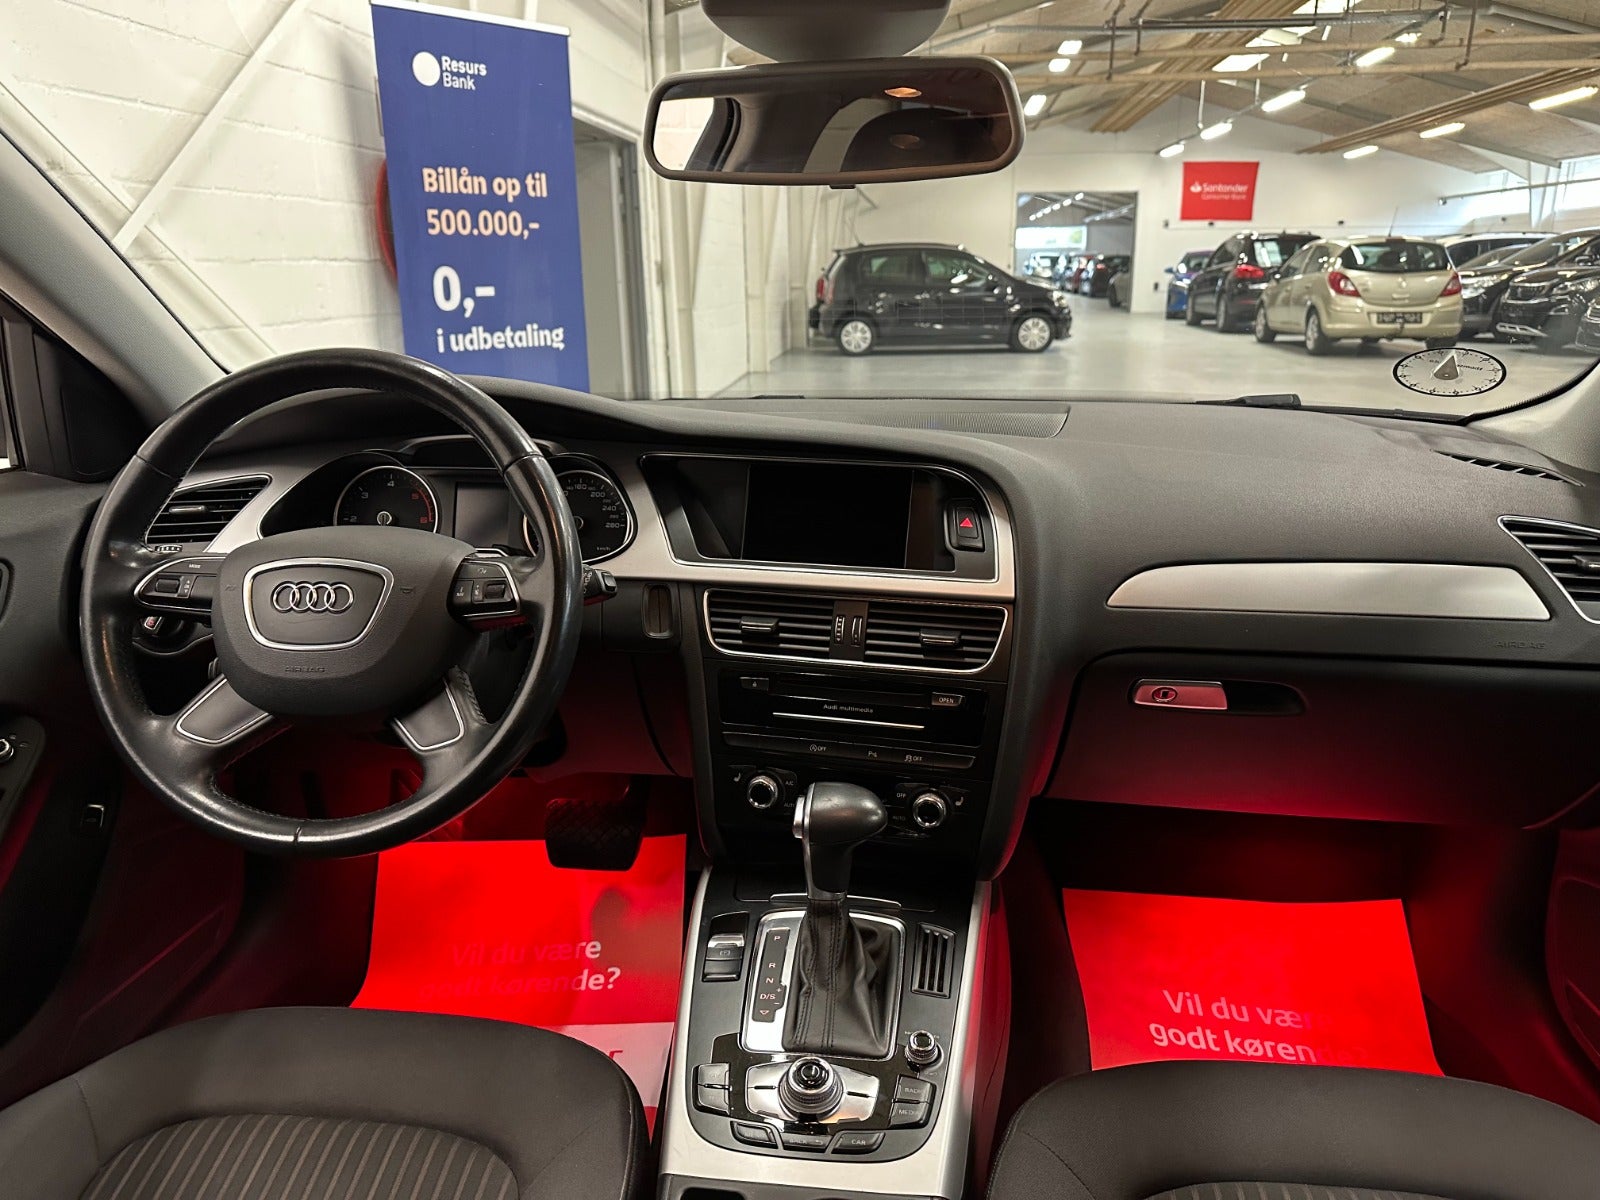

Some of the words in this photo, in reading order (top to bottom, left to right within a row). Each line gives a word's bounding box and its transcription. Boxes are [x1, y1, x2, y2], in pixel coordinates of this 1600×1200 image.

[441, 56, 487, 76] Resurs
[442, 73, 476, 90] Bank
[422, 167, 487, 195] Billån
[492, 177, 521, 202] op
[525, 173, 548, 197] til
[1202, 183, 1249, 192] Santander
[426, 208, 540, 240] 500.000,-
[433, 265, 496, 318] 0,-
[436, 328, 445, 353] i
[449, 324, 565, 352] udbetaling
[1162, 989, 1204, 1017] Vil
[1211, 996, 1250, 1022] du
[1149, 1022, 1220, 1052] godt
